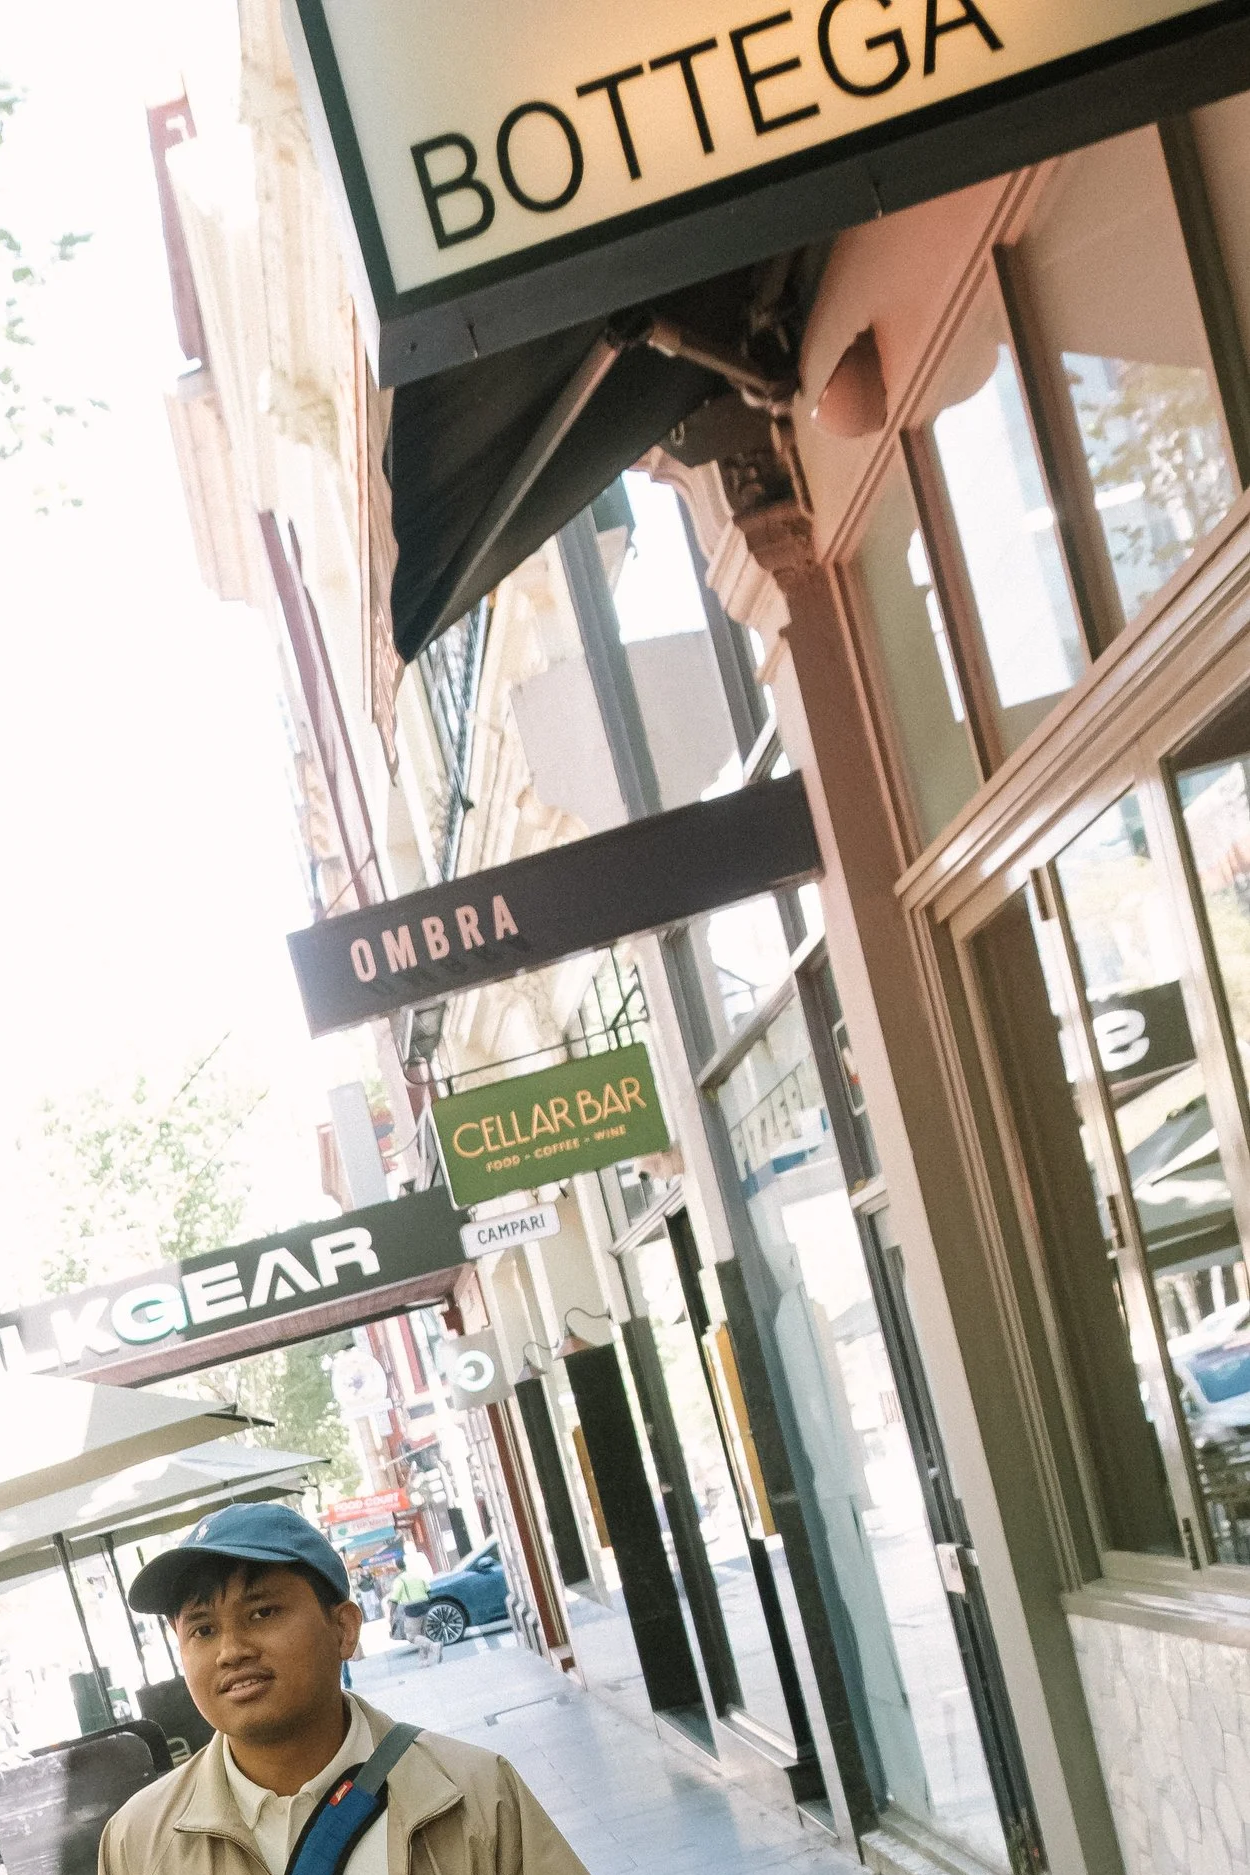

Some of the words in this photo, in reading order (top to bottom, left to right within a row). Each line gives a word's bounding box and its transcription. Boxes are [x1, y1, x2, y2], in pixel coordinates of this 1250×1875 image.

[410, 0, 1004, 250] BOTTEGA
[350, 894, 519, 983] OMBRA
[453, 1097, 576, 1159] CELLAR
[576, 1077, 647, 1126] BAR
[485, 1155, 521, 1173] FOOD
[534, 1137, 580, 1159] COFFEE
[593, 1124, 627, 1141] WINE
[477, 1213, 546, 1245] CAMPARI
